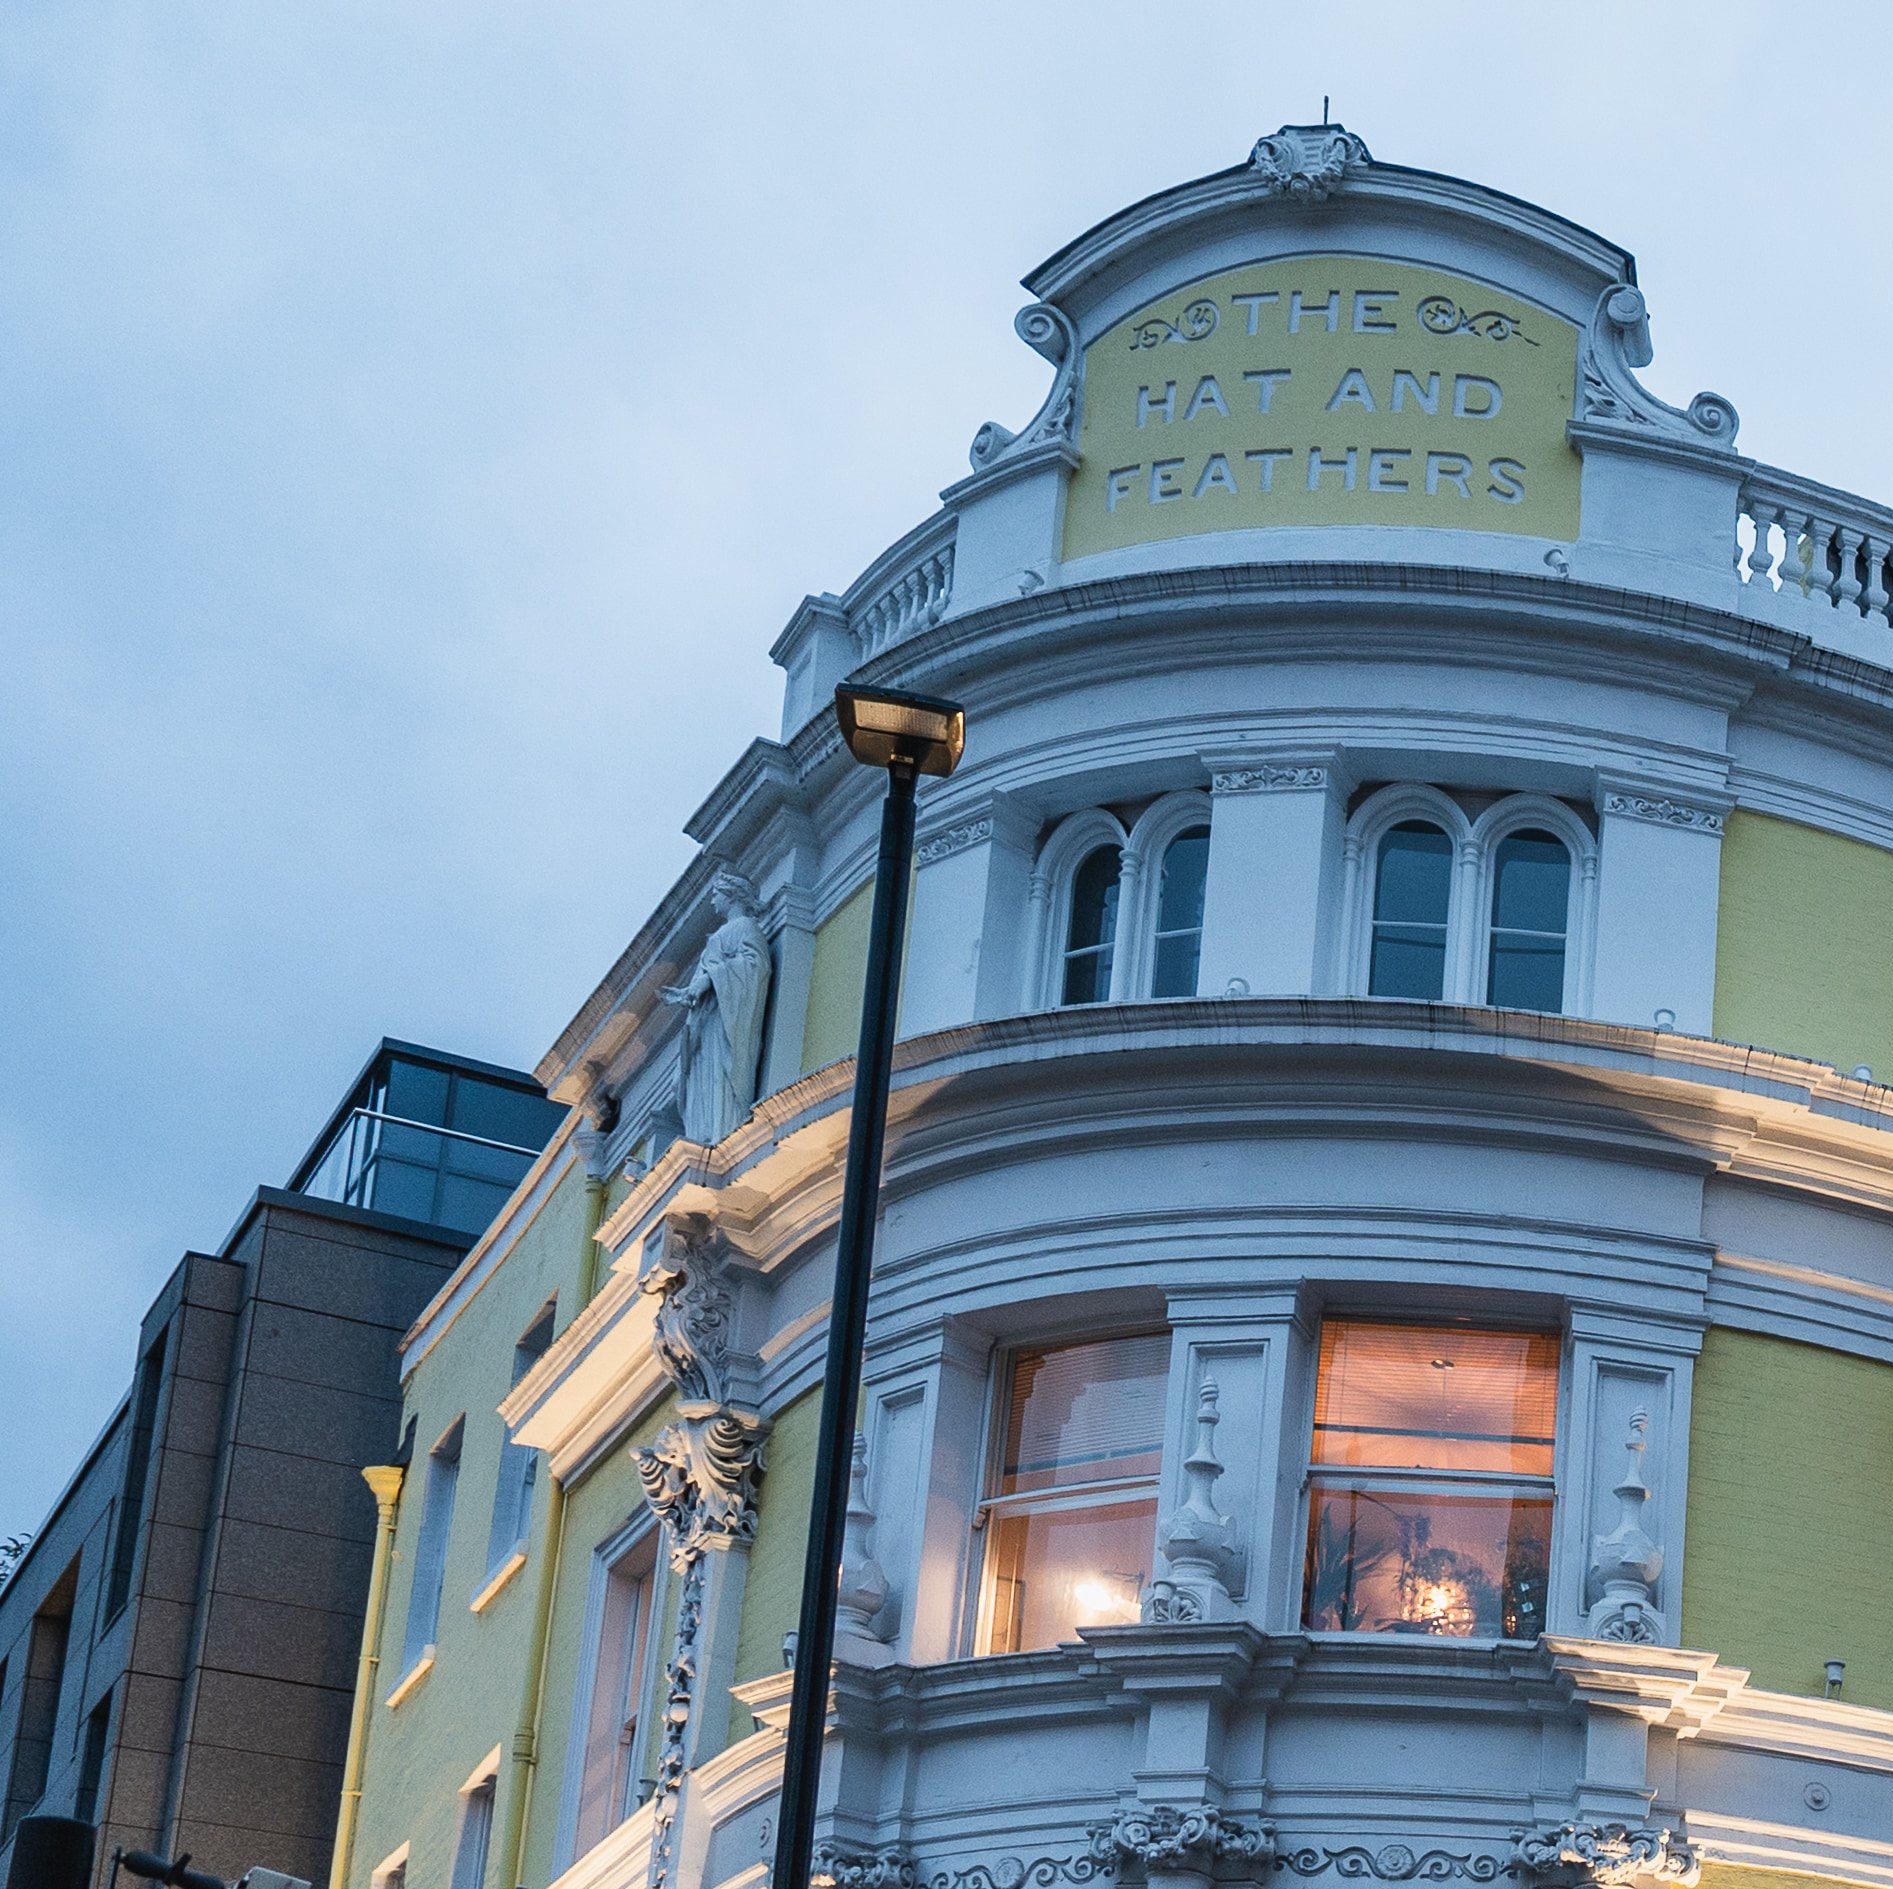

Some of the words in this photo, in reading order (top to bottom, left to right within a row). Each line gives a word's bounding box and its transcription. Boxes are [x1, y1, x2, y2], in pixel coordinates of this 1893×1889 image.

[1231, 289, 1400, 337] THE
[1135, 367, 1293, 429] HAT
[1325, 367, 1503, 421] AND
[1105, 445, 1528, 514] FEATHERS
